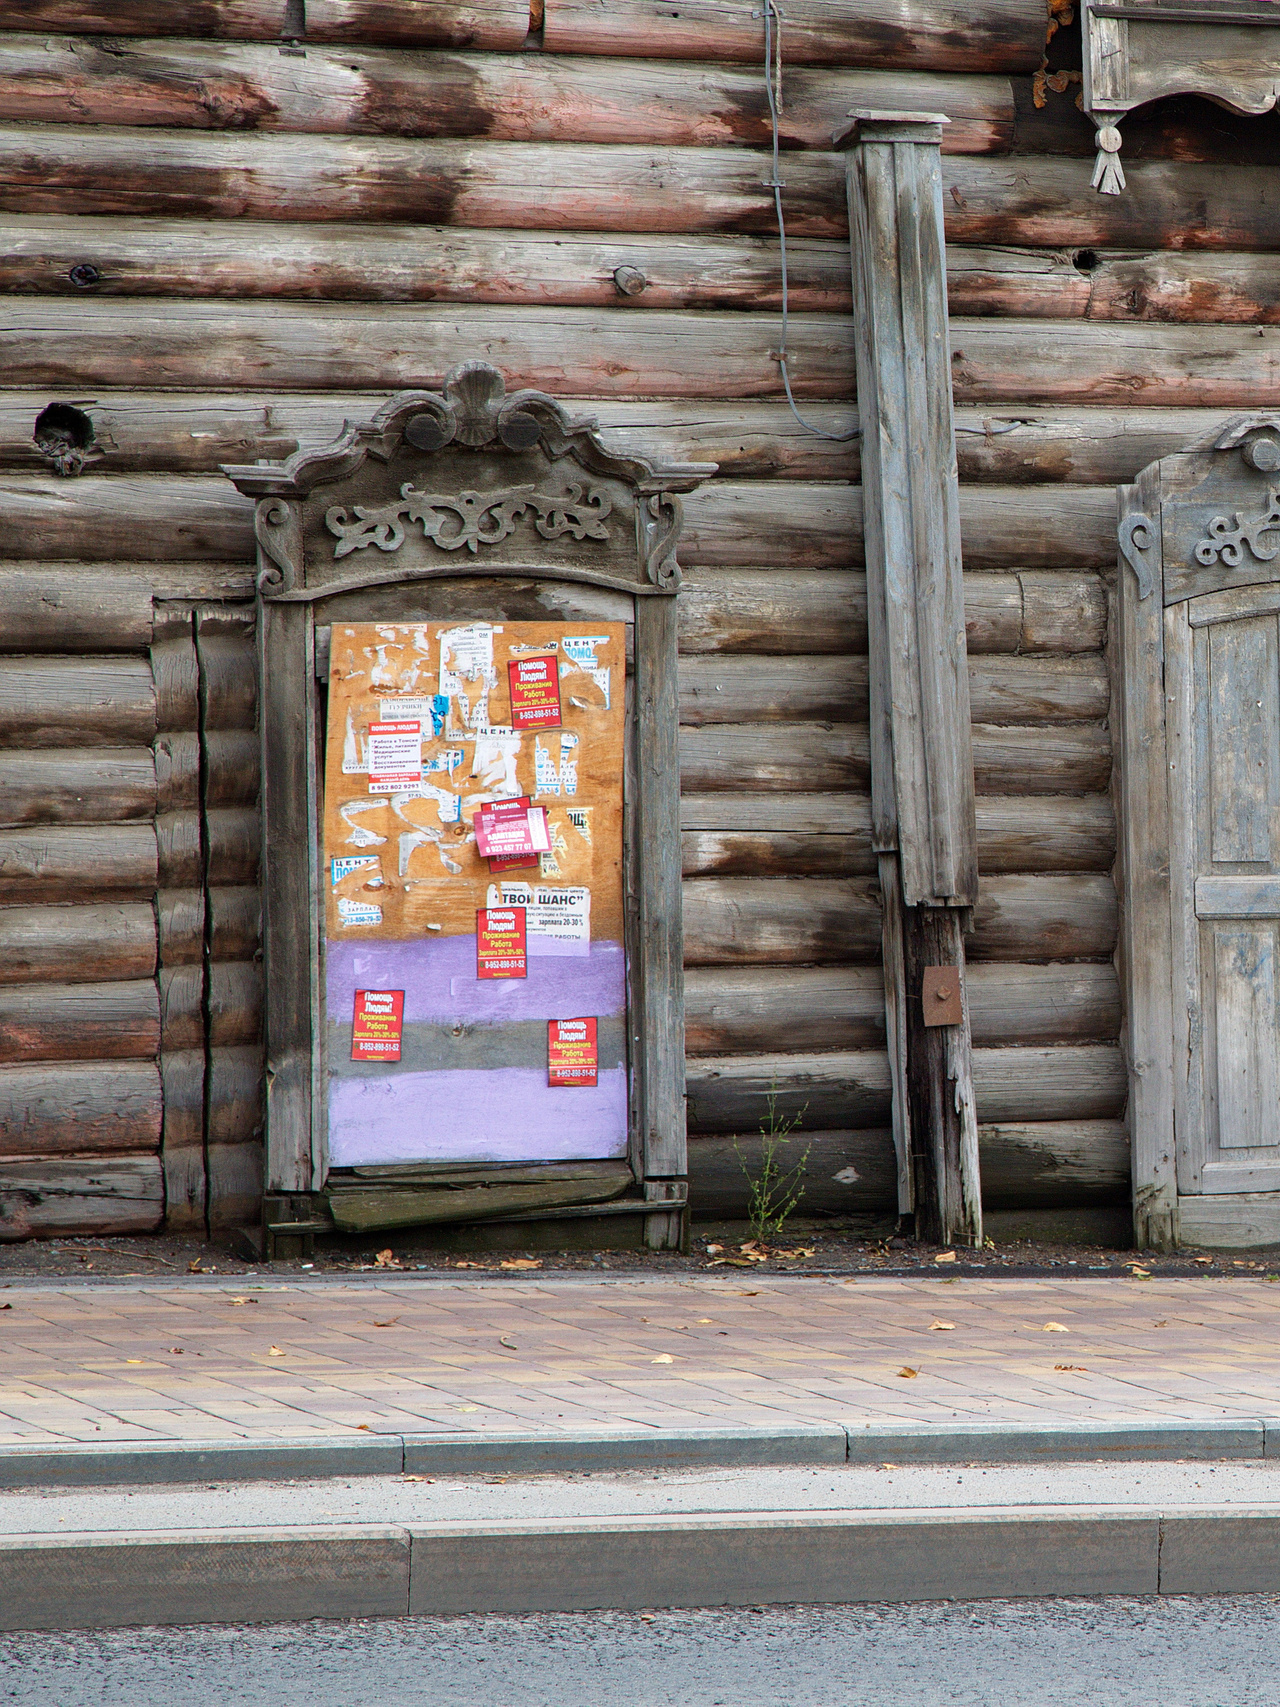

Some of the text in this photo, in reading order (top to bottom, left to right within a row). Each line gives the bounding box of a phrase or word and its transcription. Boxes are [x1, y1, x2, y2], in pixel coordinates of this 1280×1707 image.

[565, 647, 598, 659] ПОМО
[518, 660, 547, 671] Помощь
[520, 670, 547, 682] Людям!
[515, 681, 552, 691] Проживание
[487, 910, 516, 920] Помощь
[488, 921, 515, 931] Людям!
[563, 918, 578, 926] 20-30
[482, 931, 520, 940] Проживание
[364, 992, 393, 1003] Помощь
[365, 1002, 392, 1014] Людям!
[359, 1013, 397, 1022] Проживание
[367, 1022, 388, 1030] Работа
[558, 1021, 587, 1030] Помощь
[559, 1030, 586, 1041] Людям!
[554, 1041, 591, 1050] Проживание
